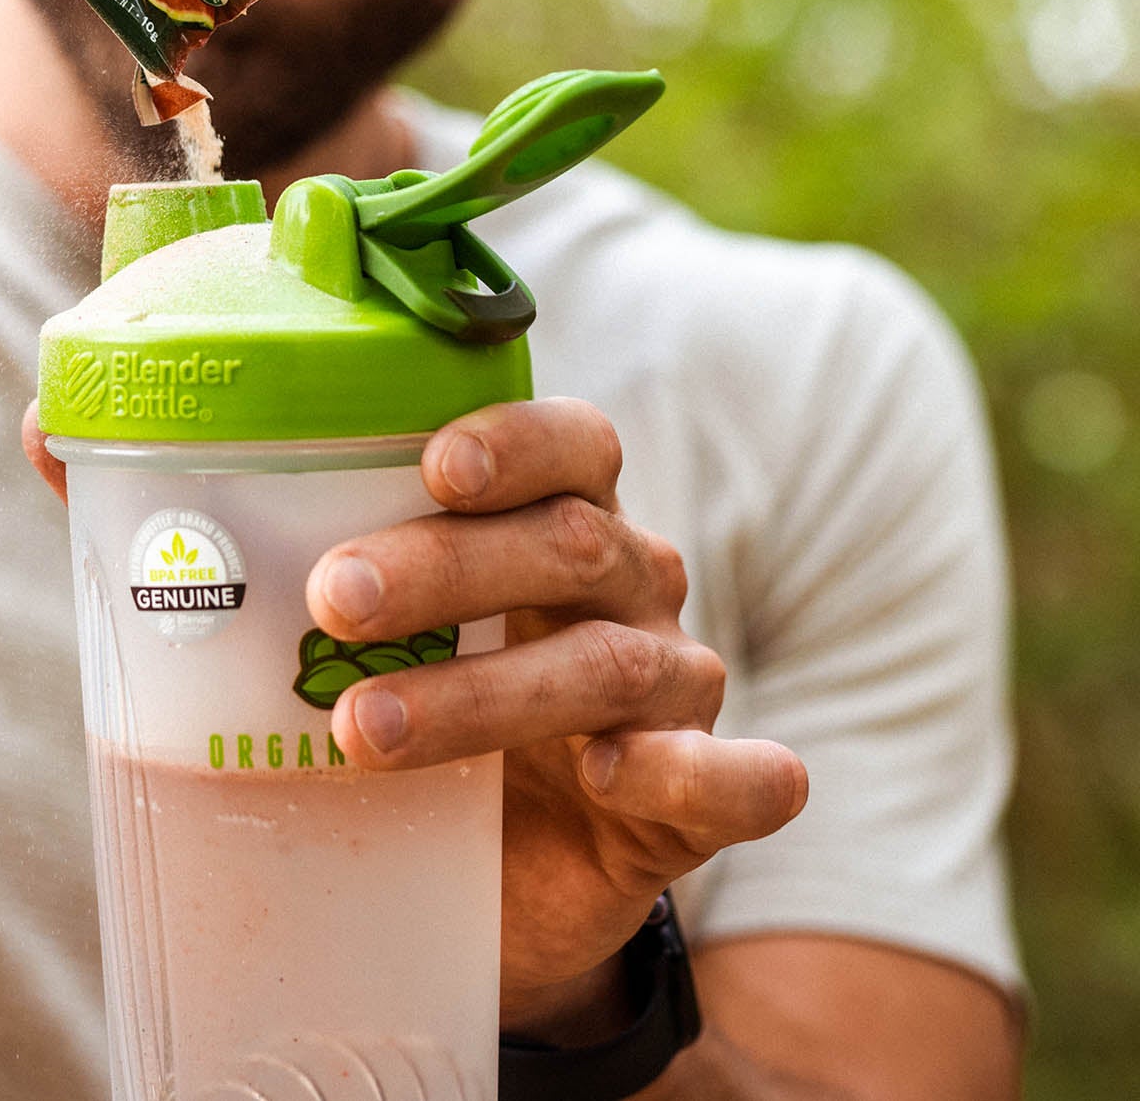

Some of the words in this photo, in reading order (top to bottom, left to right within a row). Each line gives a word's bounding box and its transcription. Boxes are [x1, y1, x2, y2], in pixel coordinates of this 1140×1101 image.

[141, 15, 159, 43] 10g
[111, 350, 243, 385] Blender
[149, 568, 176, 582] BPA
[179, 566, 217, 581] FREE
[136, 586, 236, 610] GENUINE
